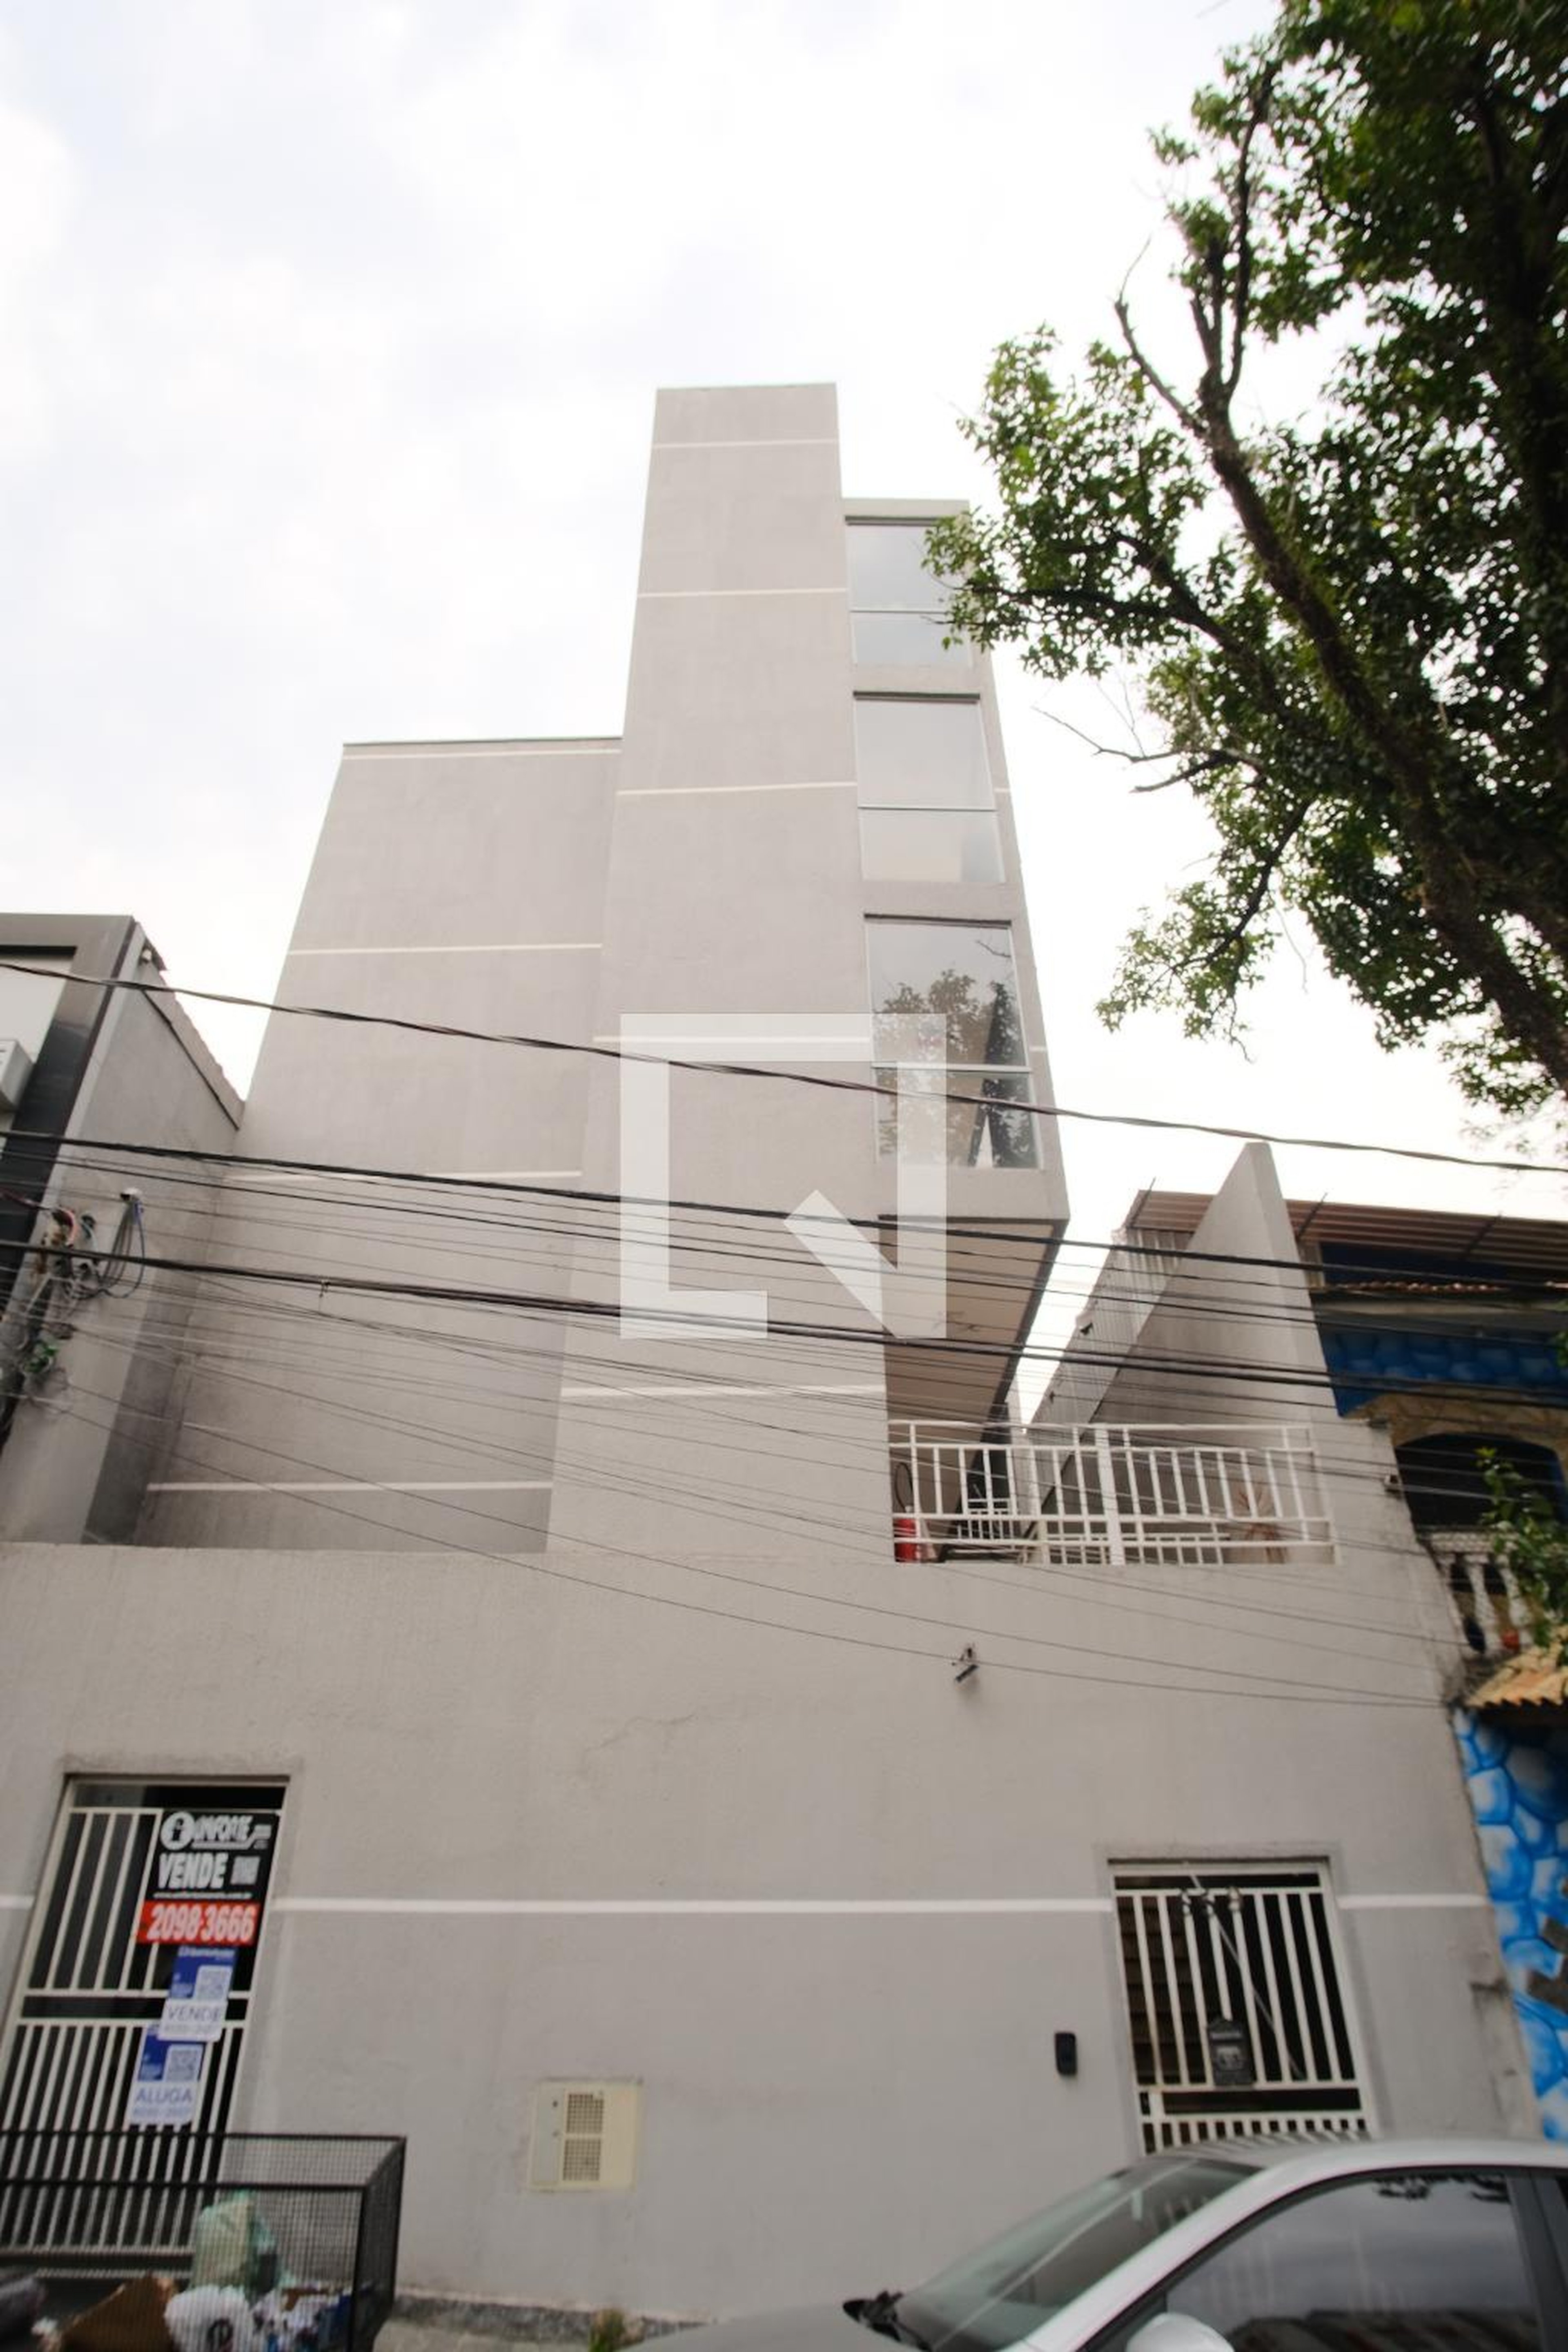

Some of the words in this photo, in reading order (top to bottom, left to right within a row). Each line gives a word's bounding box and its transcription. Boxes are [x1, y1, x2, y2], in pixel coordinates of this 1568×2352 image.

[158, 1853, 229, 1889] VENDE
[168, 2006, 222, 2021] VENDE
[136, 2087, 192, 2103] ALUGA
